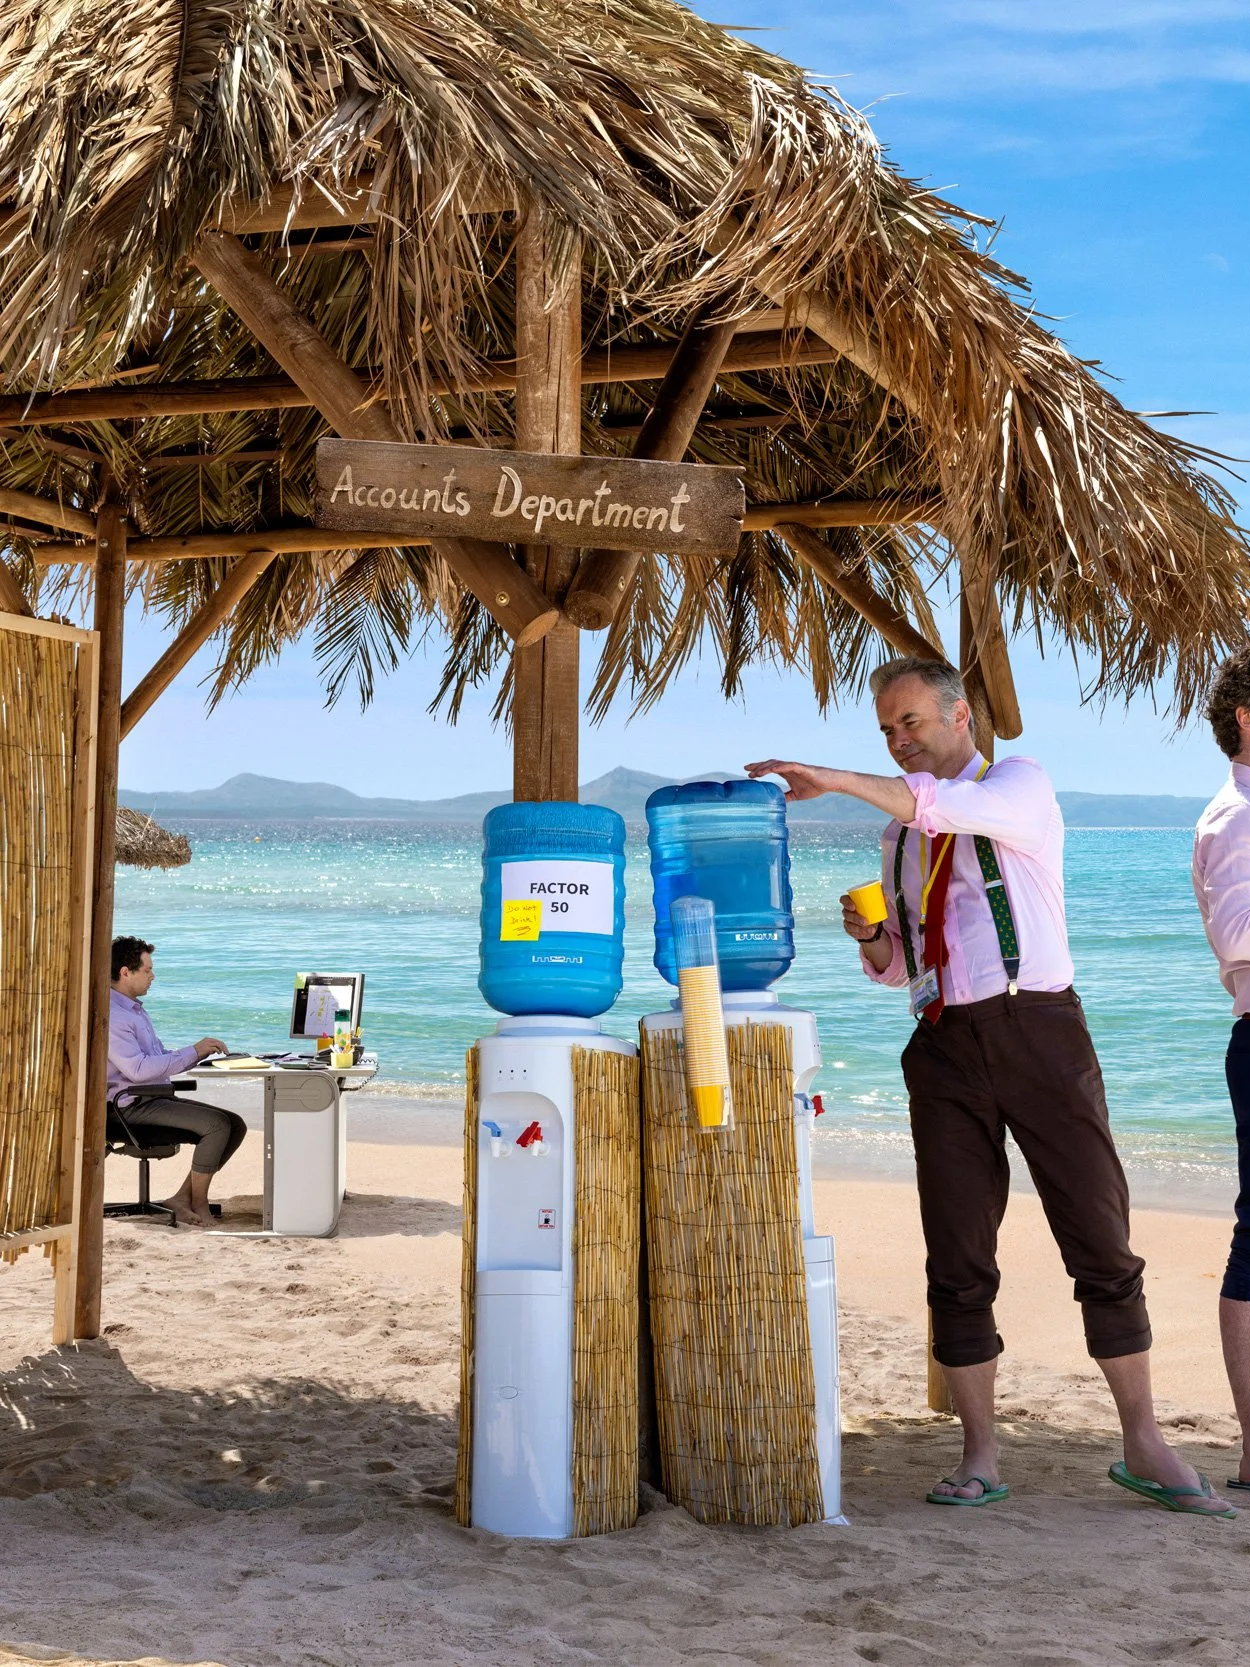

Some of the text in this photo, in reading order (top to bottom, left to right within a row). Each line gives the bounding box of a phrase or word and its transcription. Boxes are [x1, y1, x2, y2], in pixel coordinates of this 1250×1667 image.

[330, 465, 691, 533] Accounts Department
[530, 882, 589, 895] FACTOR
[550, 901, 569, 913] 50
